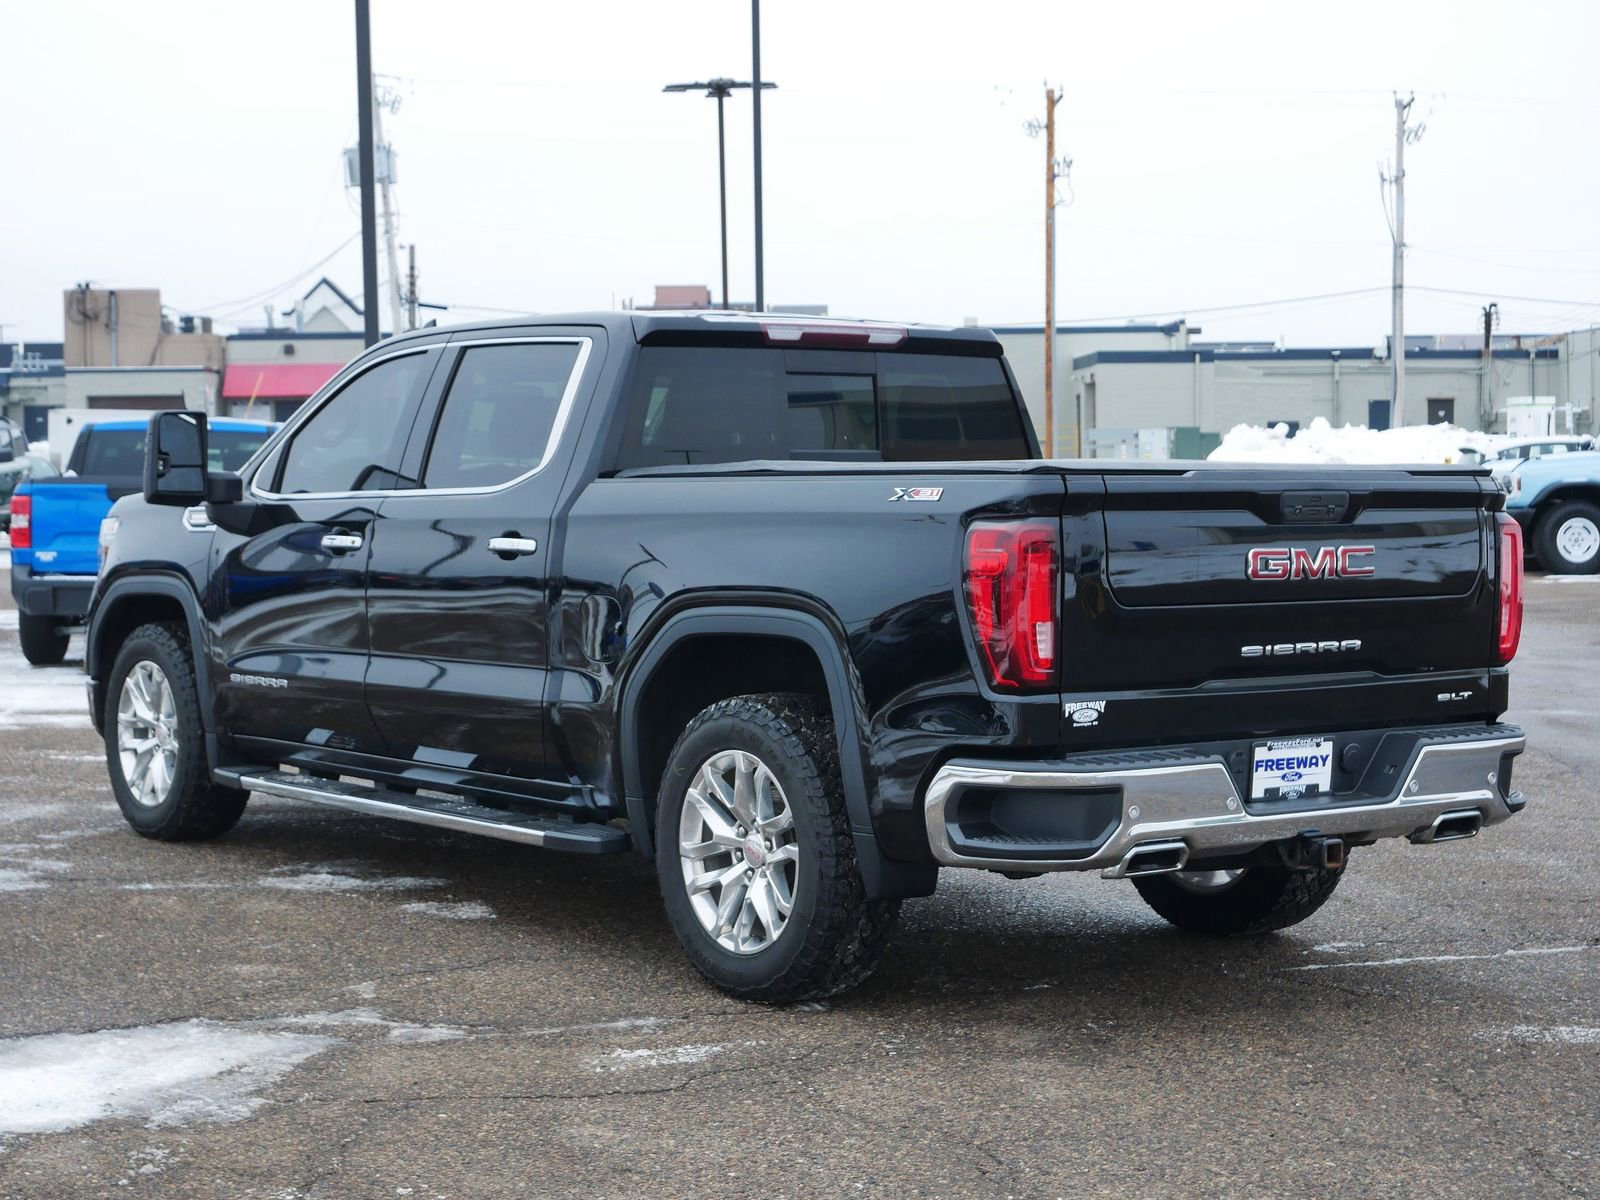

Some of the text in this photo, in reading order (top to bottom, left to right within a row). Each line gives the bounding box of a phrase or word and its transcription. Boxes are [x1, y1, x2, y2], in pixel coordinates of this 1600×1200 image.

[1246, 545, 1376, 581] GMC
[1240, 639, 1361, 657] SIERRA
[230, 673, 288, 688] SIERRA
[1437, 691, 1473, 702] SLT
[1064, 700, 1106, 718] FREEWAY
[1254, 754, 1330, 773] FREEWAY
[1283, 772, 1300, 781] Ford
